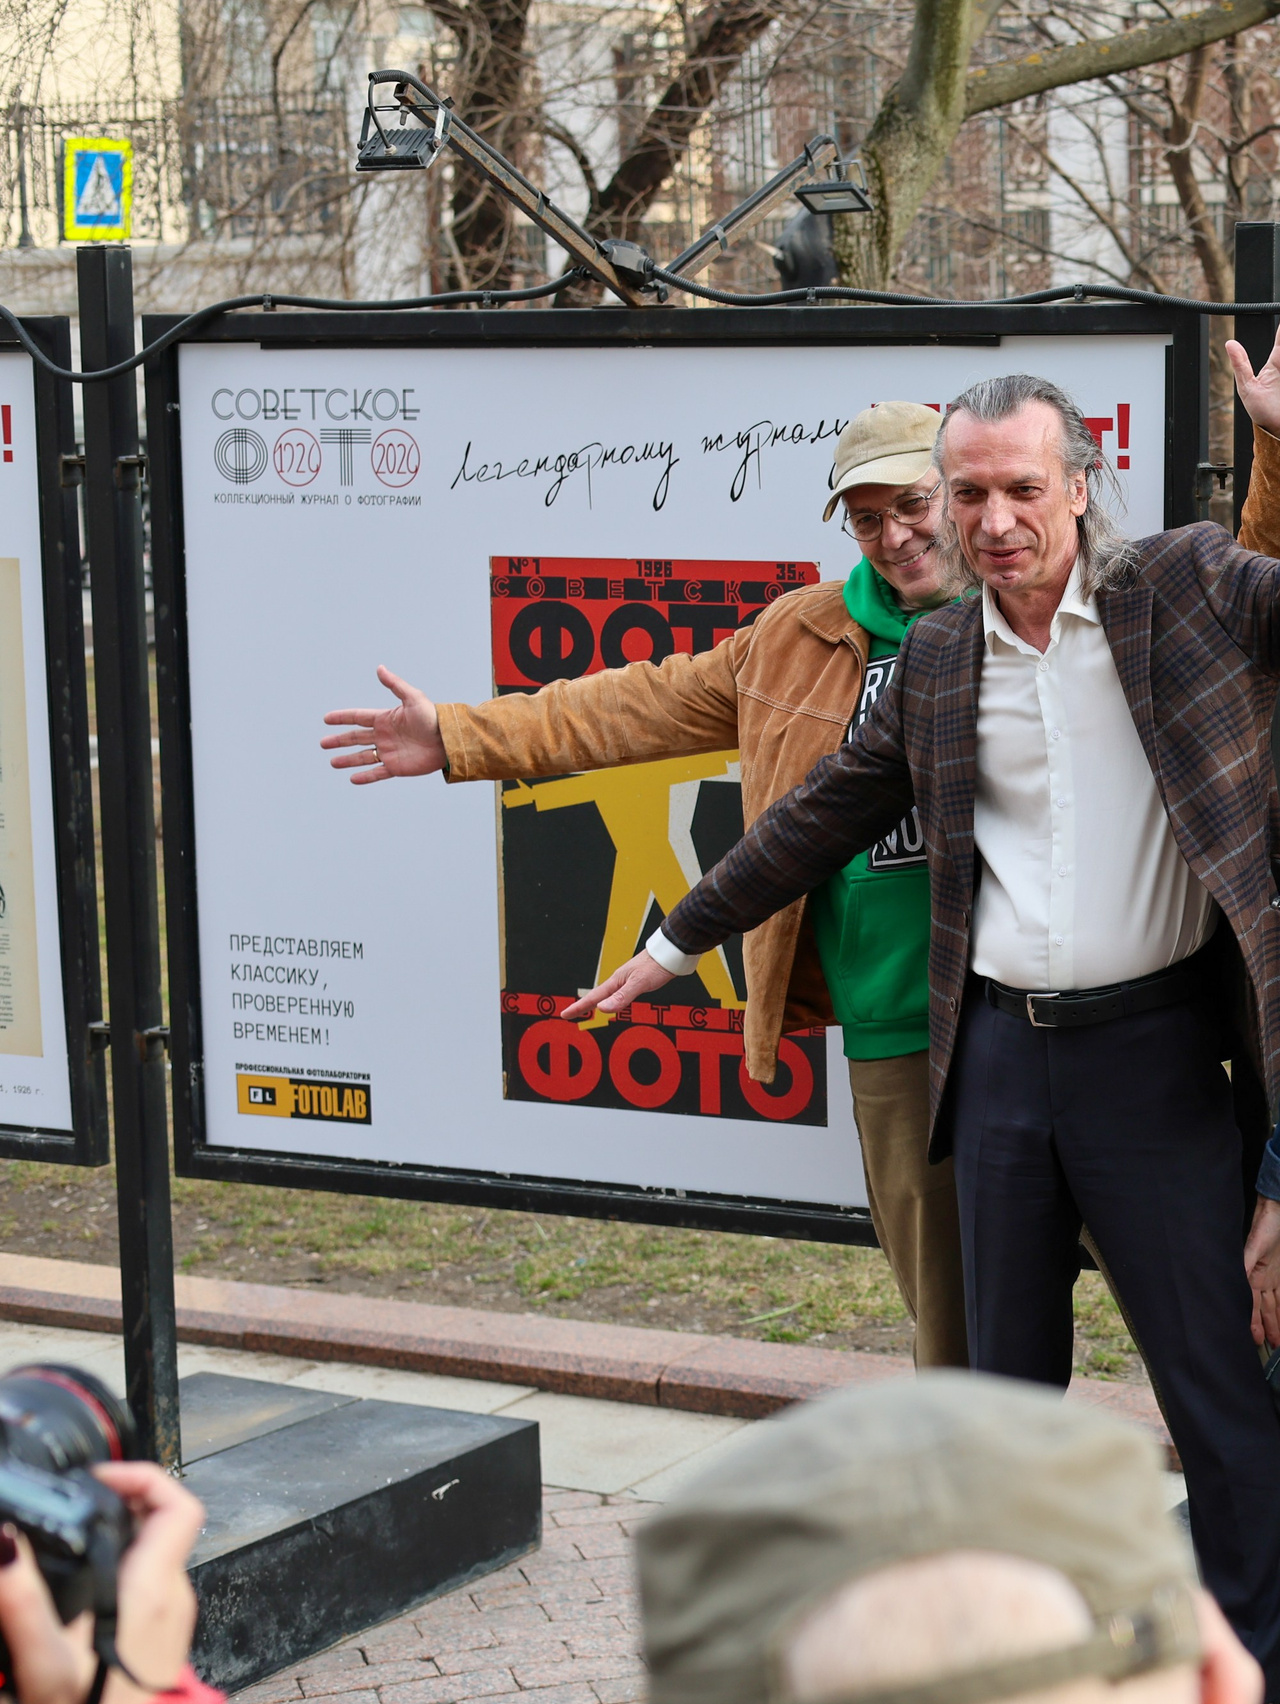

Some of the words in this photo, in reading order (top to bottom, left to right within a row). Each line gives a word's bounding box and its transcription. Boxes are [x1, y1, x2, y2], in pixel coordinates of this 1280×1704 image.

[212, 388, 420, 421] СОВЕТСКОЕ
[214, 493, 294, 505] КОЛЛЕКЦИОННЫЙ
[301, 494, 339, 505] ЖУРНАЛ
[345, 495, 351, 506] О
[357, 495, 422, 506] ФОТОГРАФИИ
[636, 561, 672, 577] 1926
[493, 576, 784, 602] СОВЕТСКО
[230, 934, 364, 960] ПРЕДСТАВЛЯЕМ
[232, 993, 355, 1018] ПРОВЕРЕННУЮ
[503, 993, 827, 1037] СОЕТСКЕ
[234, 1022, 330, 1046] ВРЕМЕНЕМ!
[235, 1062, 305, 1076] ПРОФЕССИОНАЛЬНАЯ
[306, 1069, 371, 1081] ФОТОЛАБОРАТОРИЯ
[519, 1018, 814, 1121] ФОТО
[290, 1084, 367, 1119] FOTOLAB
